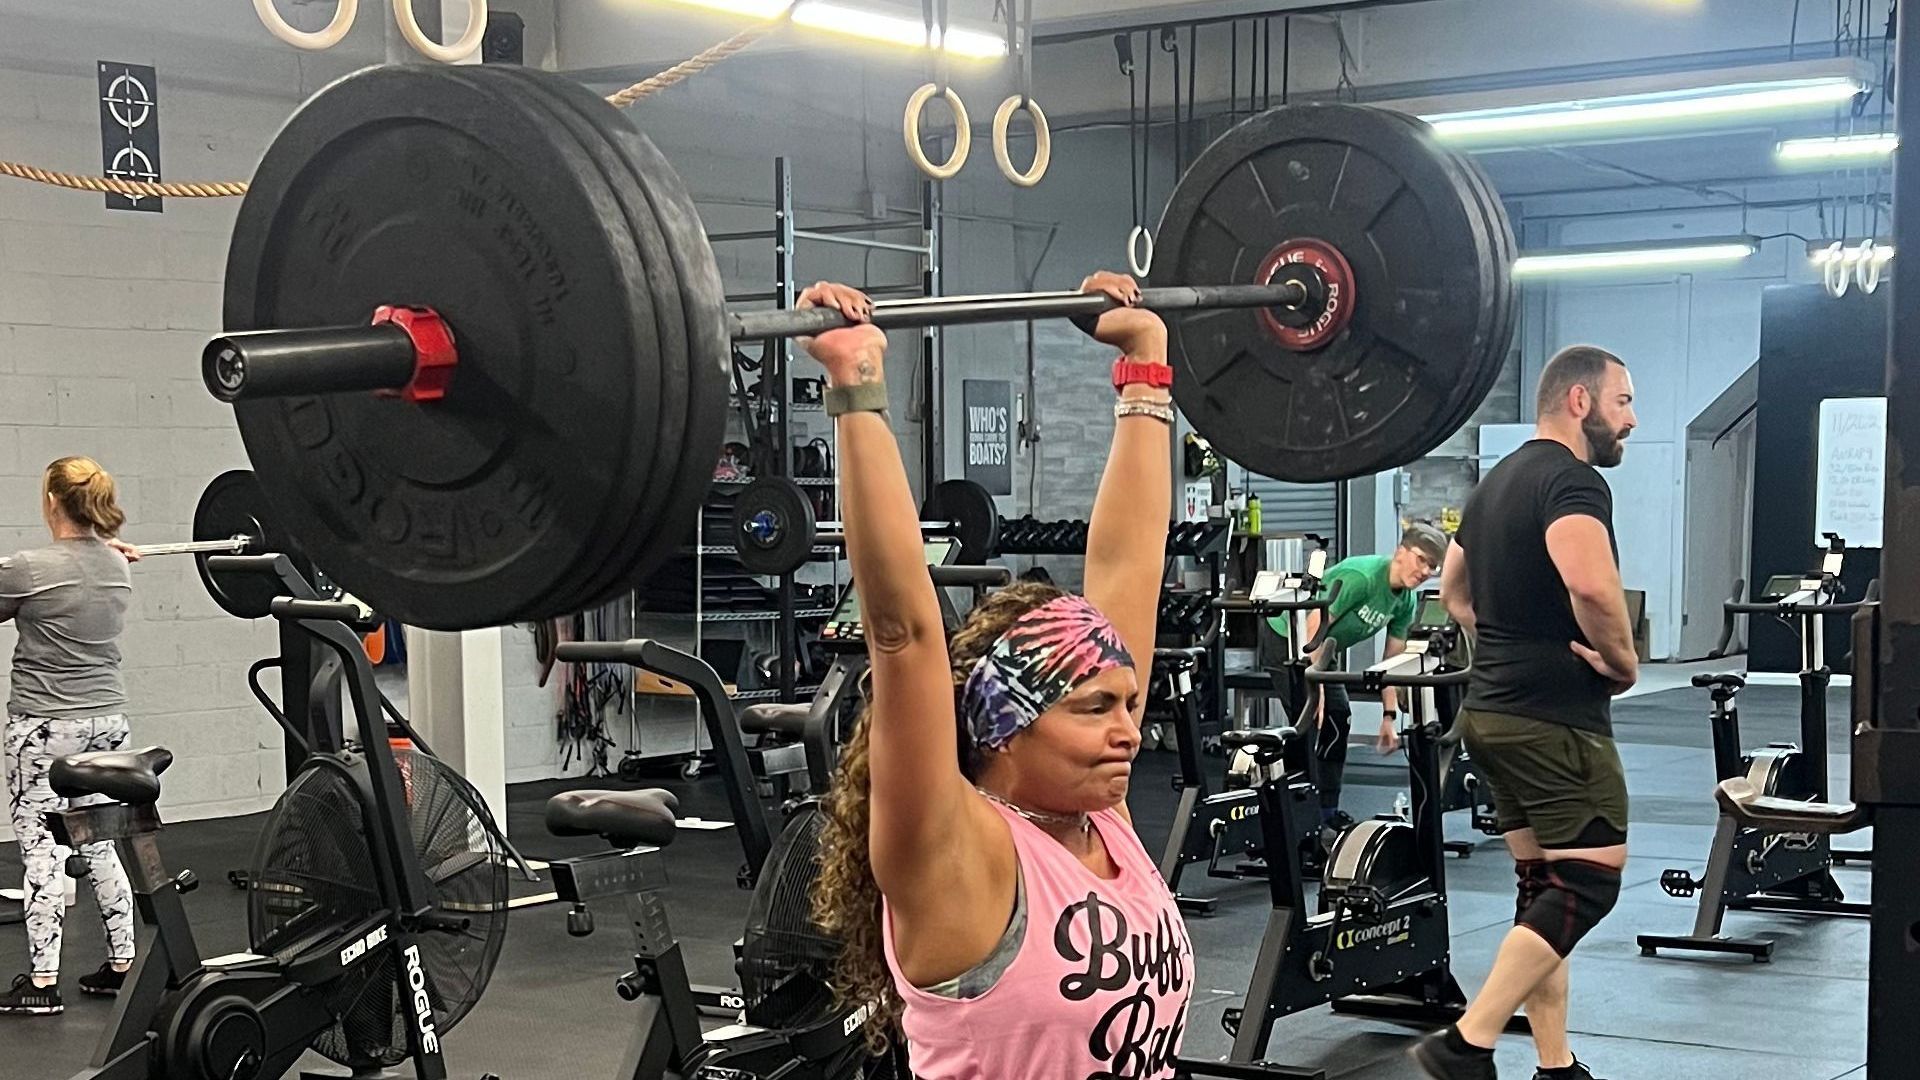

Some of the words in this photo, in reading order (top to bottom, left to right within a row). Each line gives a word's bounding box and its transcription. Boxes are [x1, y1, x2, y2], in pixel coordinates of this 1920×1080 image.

[969, 406, 1007, 432] WHO'S
[969, 442, 1007, 465] BOATS?
[340, 938, 366, 966] ECHO
[404, 944, 439, 1054] ROGUE
